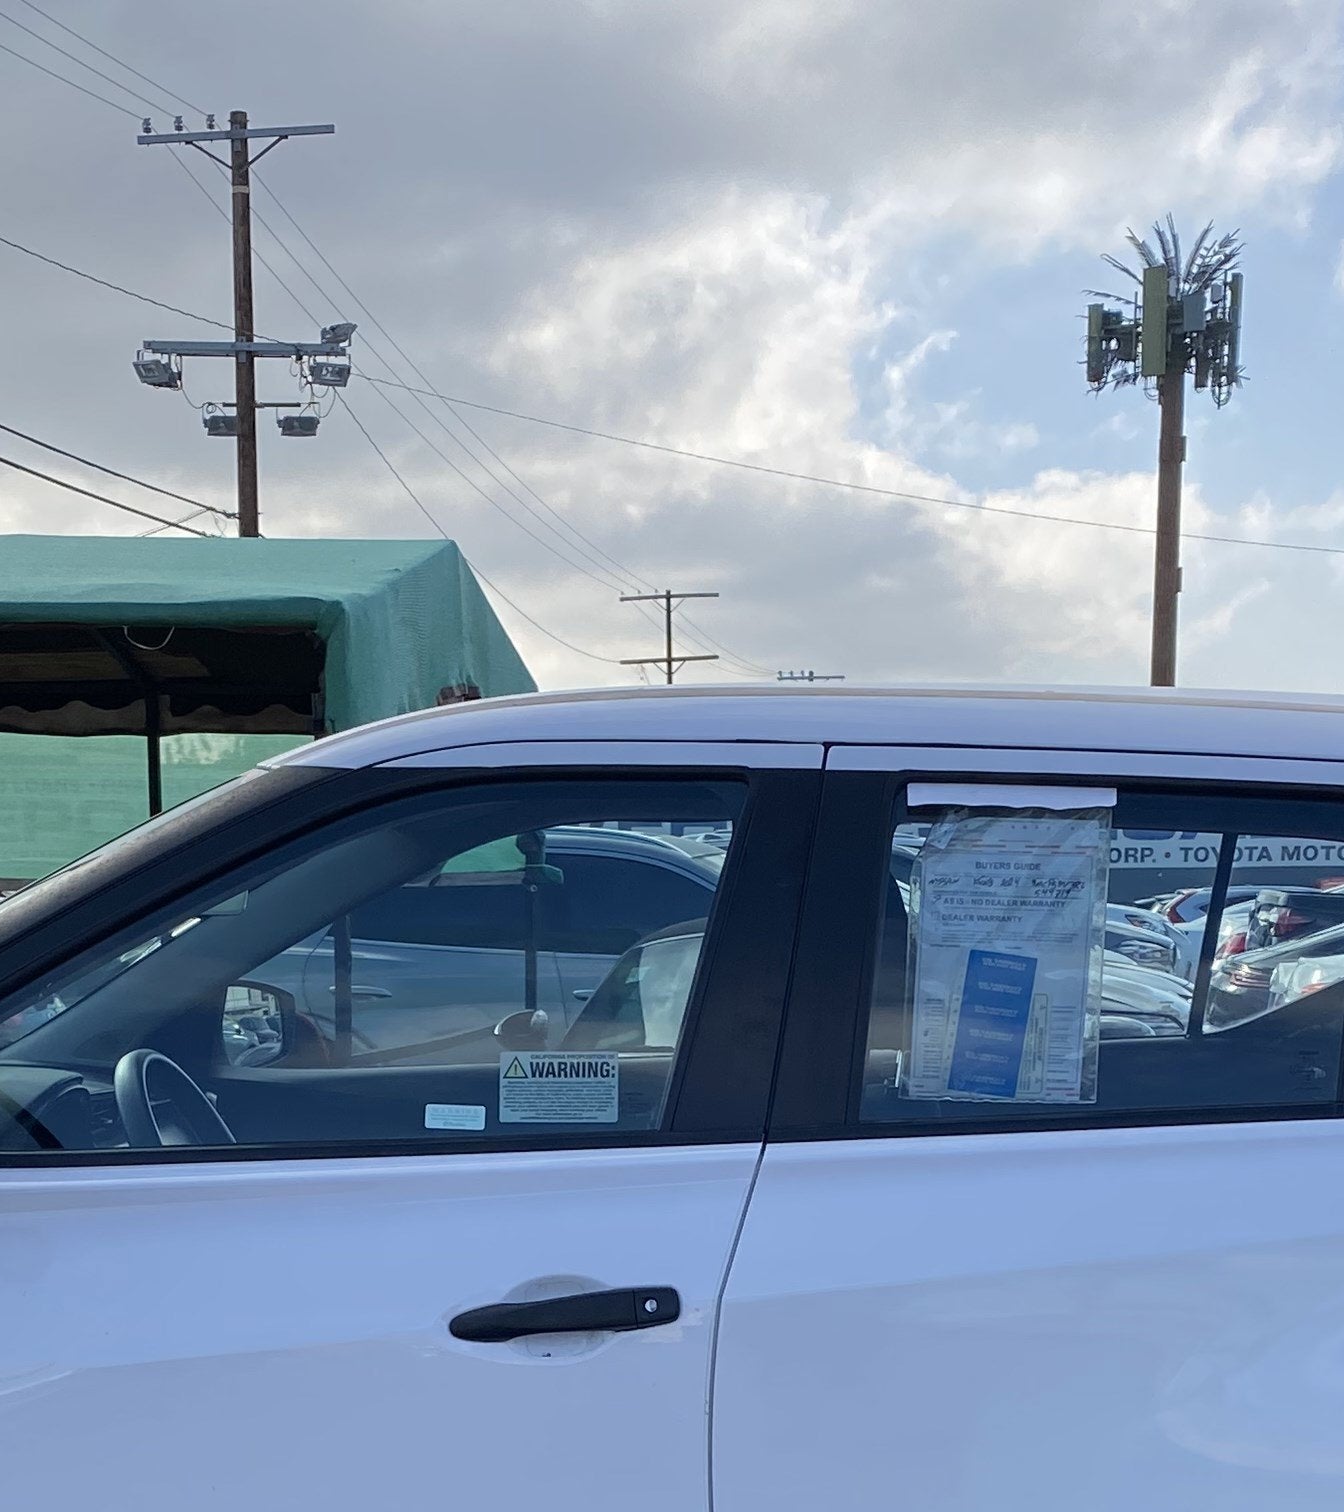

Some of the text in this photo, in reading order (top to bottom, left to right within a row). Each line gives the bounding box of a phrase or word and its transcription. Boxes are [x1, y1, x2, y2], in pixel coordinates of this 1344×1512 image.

[1109, 847, 1156, 864] ORP.
[975, 861, 1041, 871] BUYERS GUIDE
[529, 1061, 615, 1079] WARNING:
